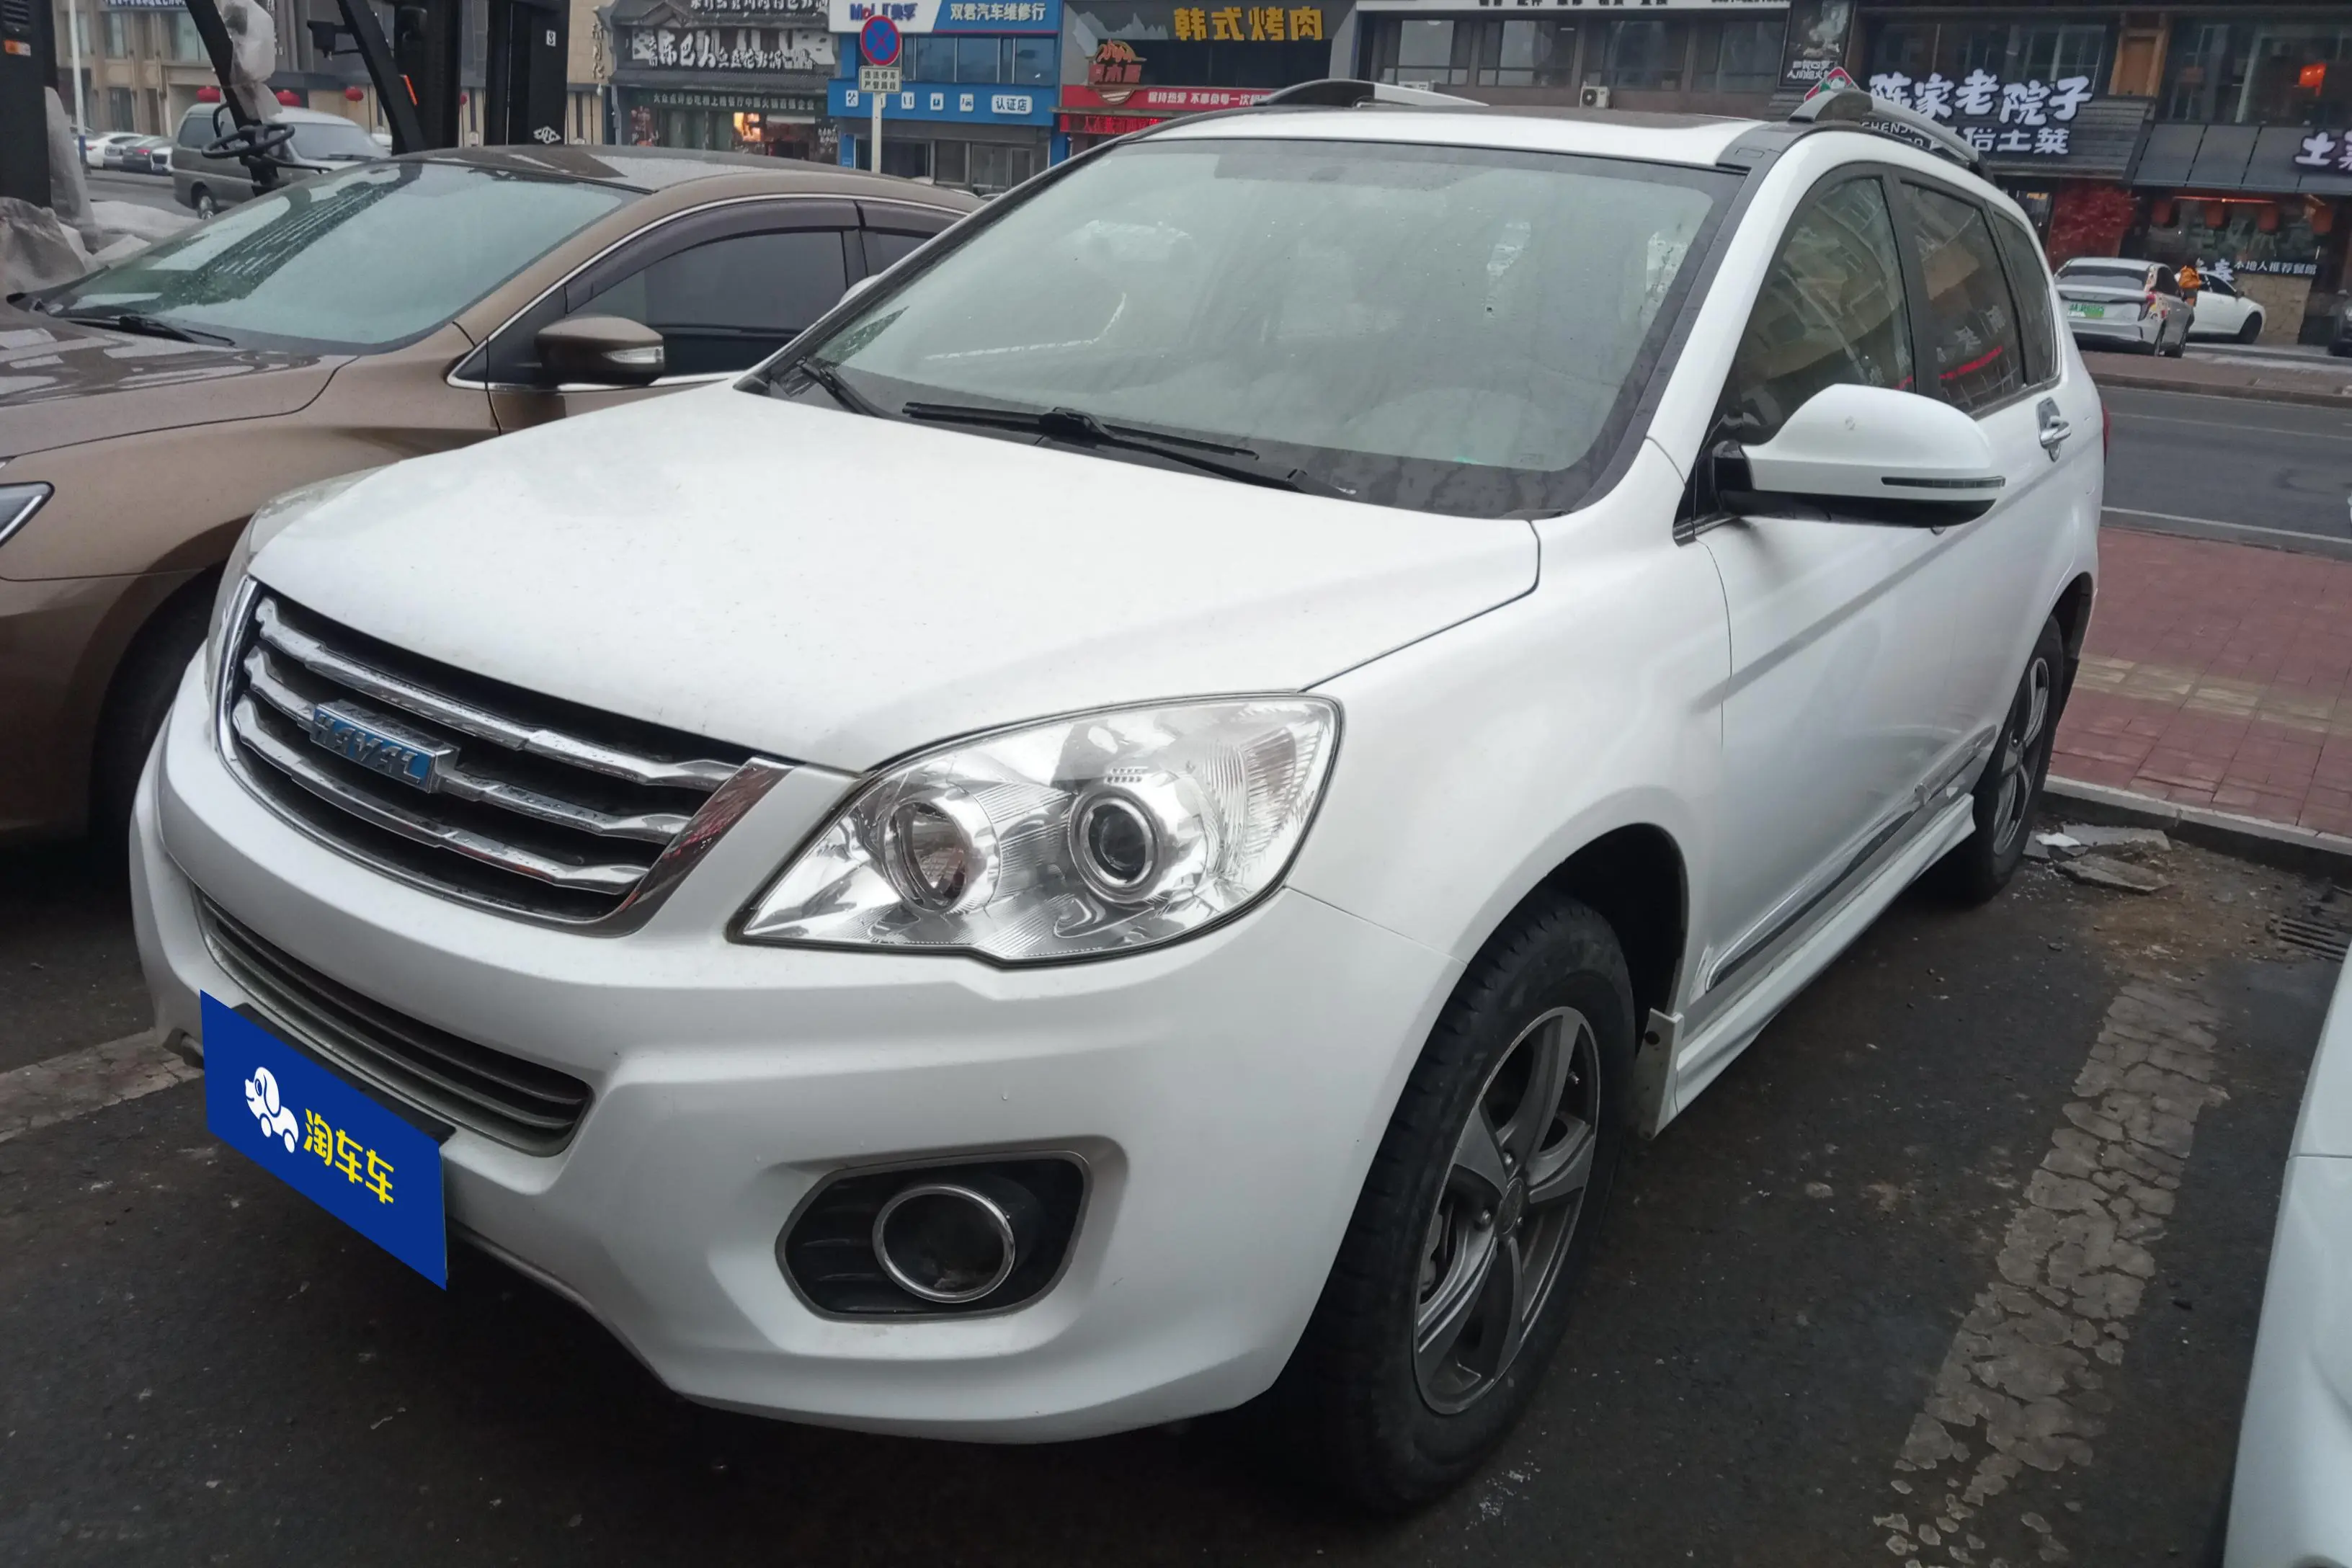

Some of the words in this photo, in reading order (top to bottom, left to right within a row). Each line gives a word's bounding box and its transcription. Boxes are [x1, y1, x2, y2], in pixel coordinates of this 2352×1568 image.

[950, 3, 1046, 21] 双君汽车维修行
[1174, 6, 1323, 41] 韩式烤肉
[996, 97, 1027, 111] 认证店
[1868, 68, 2093, 126] 陈家老院子
